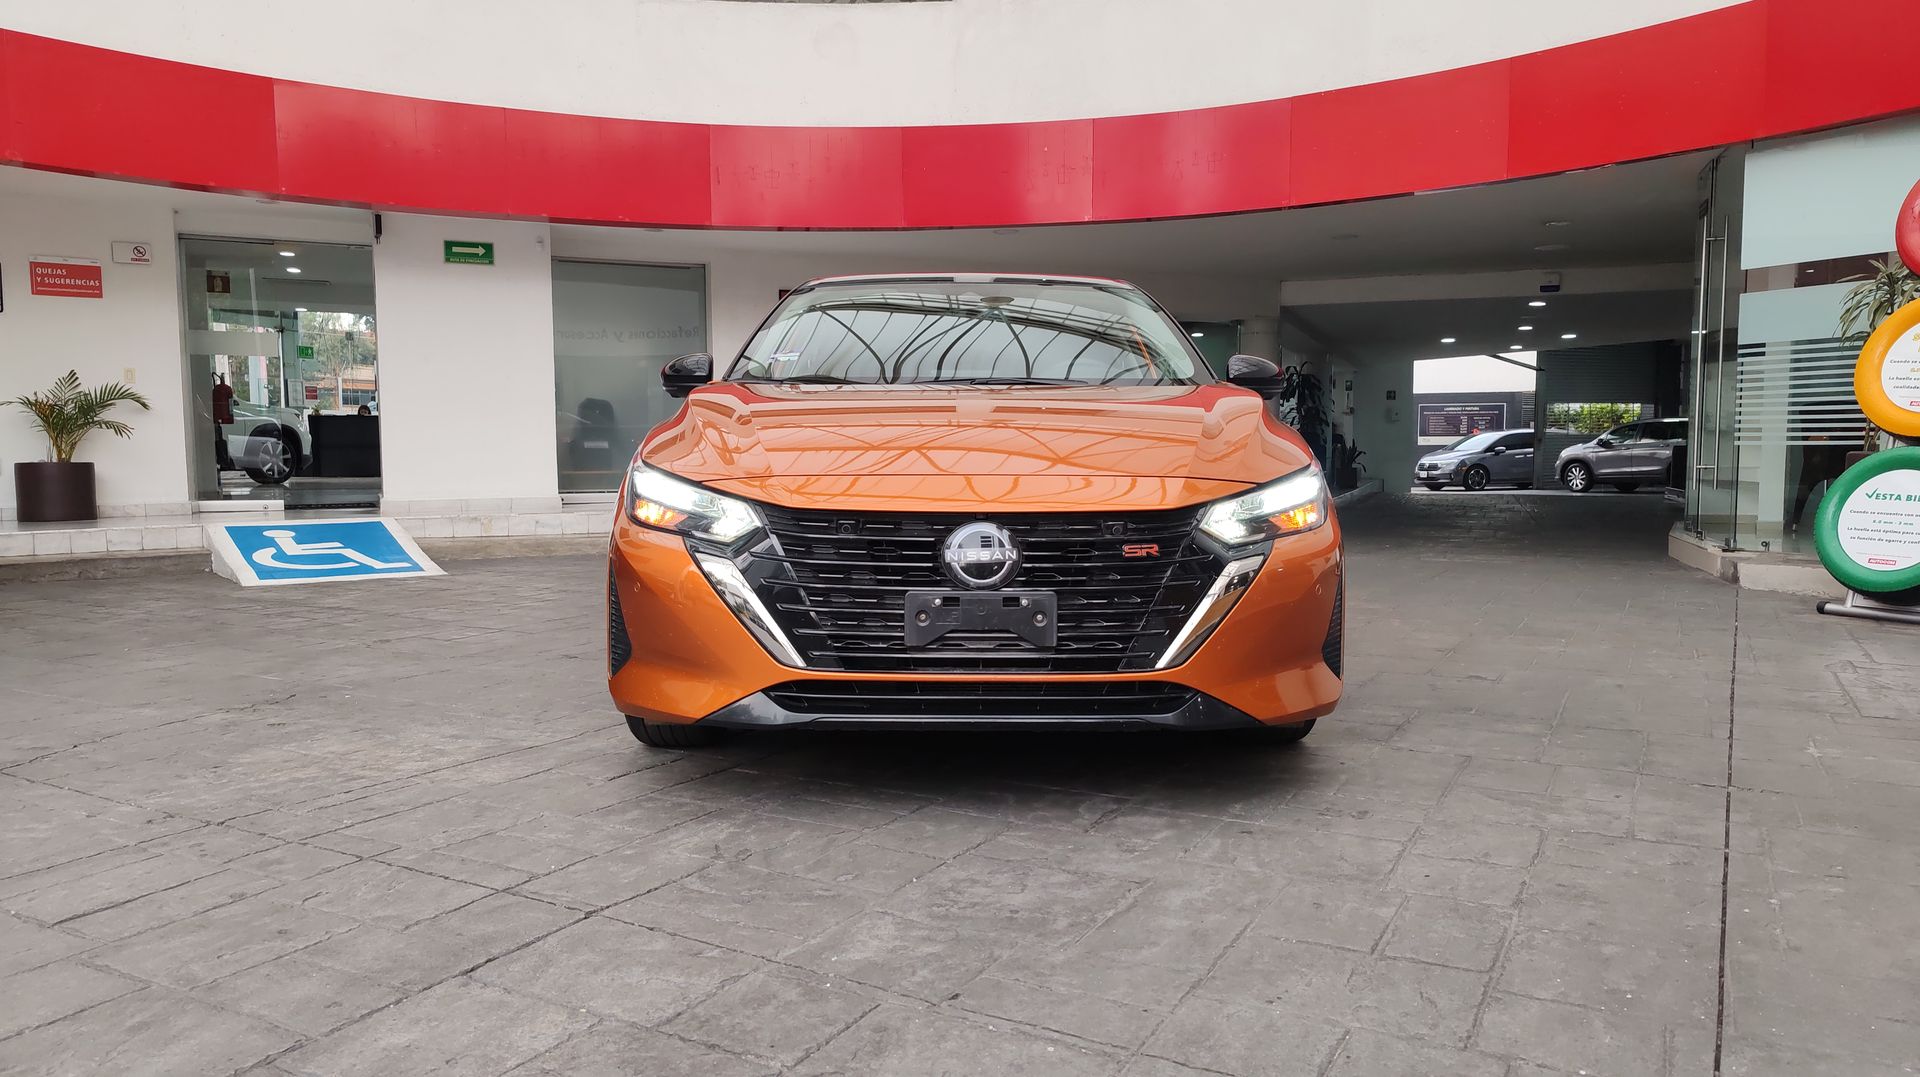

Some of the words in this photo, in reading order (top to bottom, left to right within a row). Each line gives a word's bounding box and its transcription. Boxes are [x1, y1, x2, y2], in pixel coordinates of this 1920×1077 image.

[36, 267, 67, 275] QUEJAS
[44, 277, 100, 287] SUGERENCIAS
[947, 550, 1017, 562] NISSAN
[1122, 544, 1160, 557] SR
